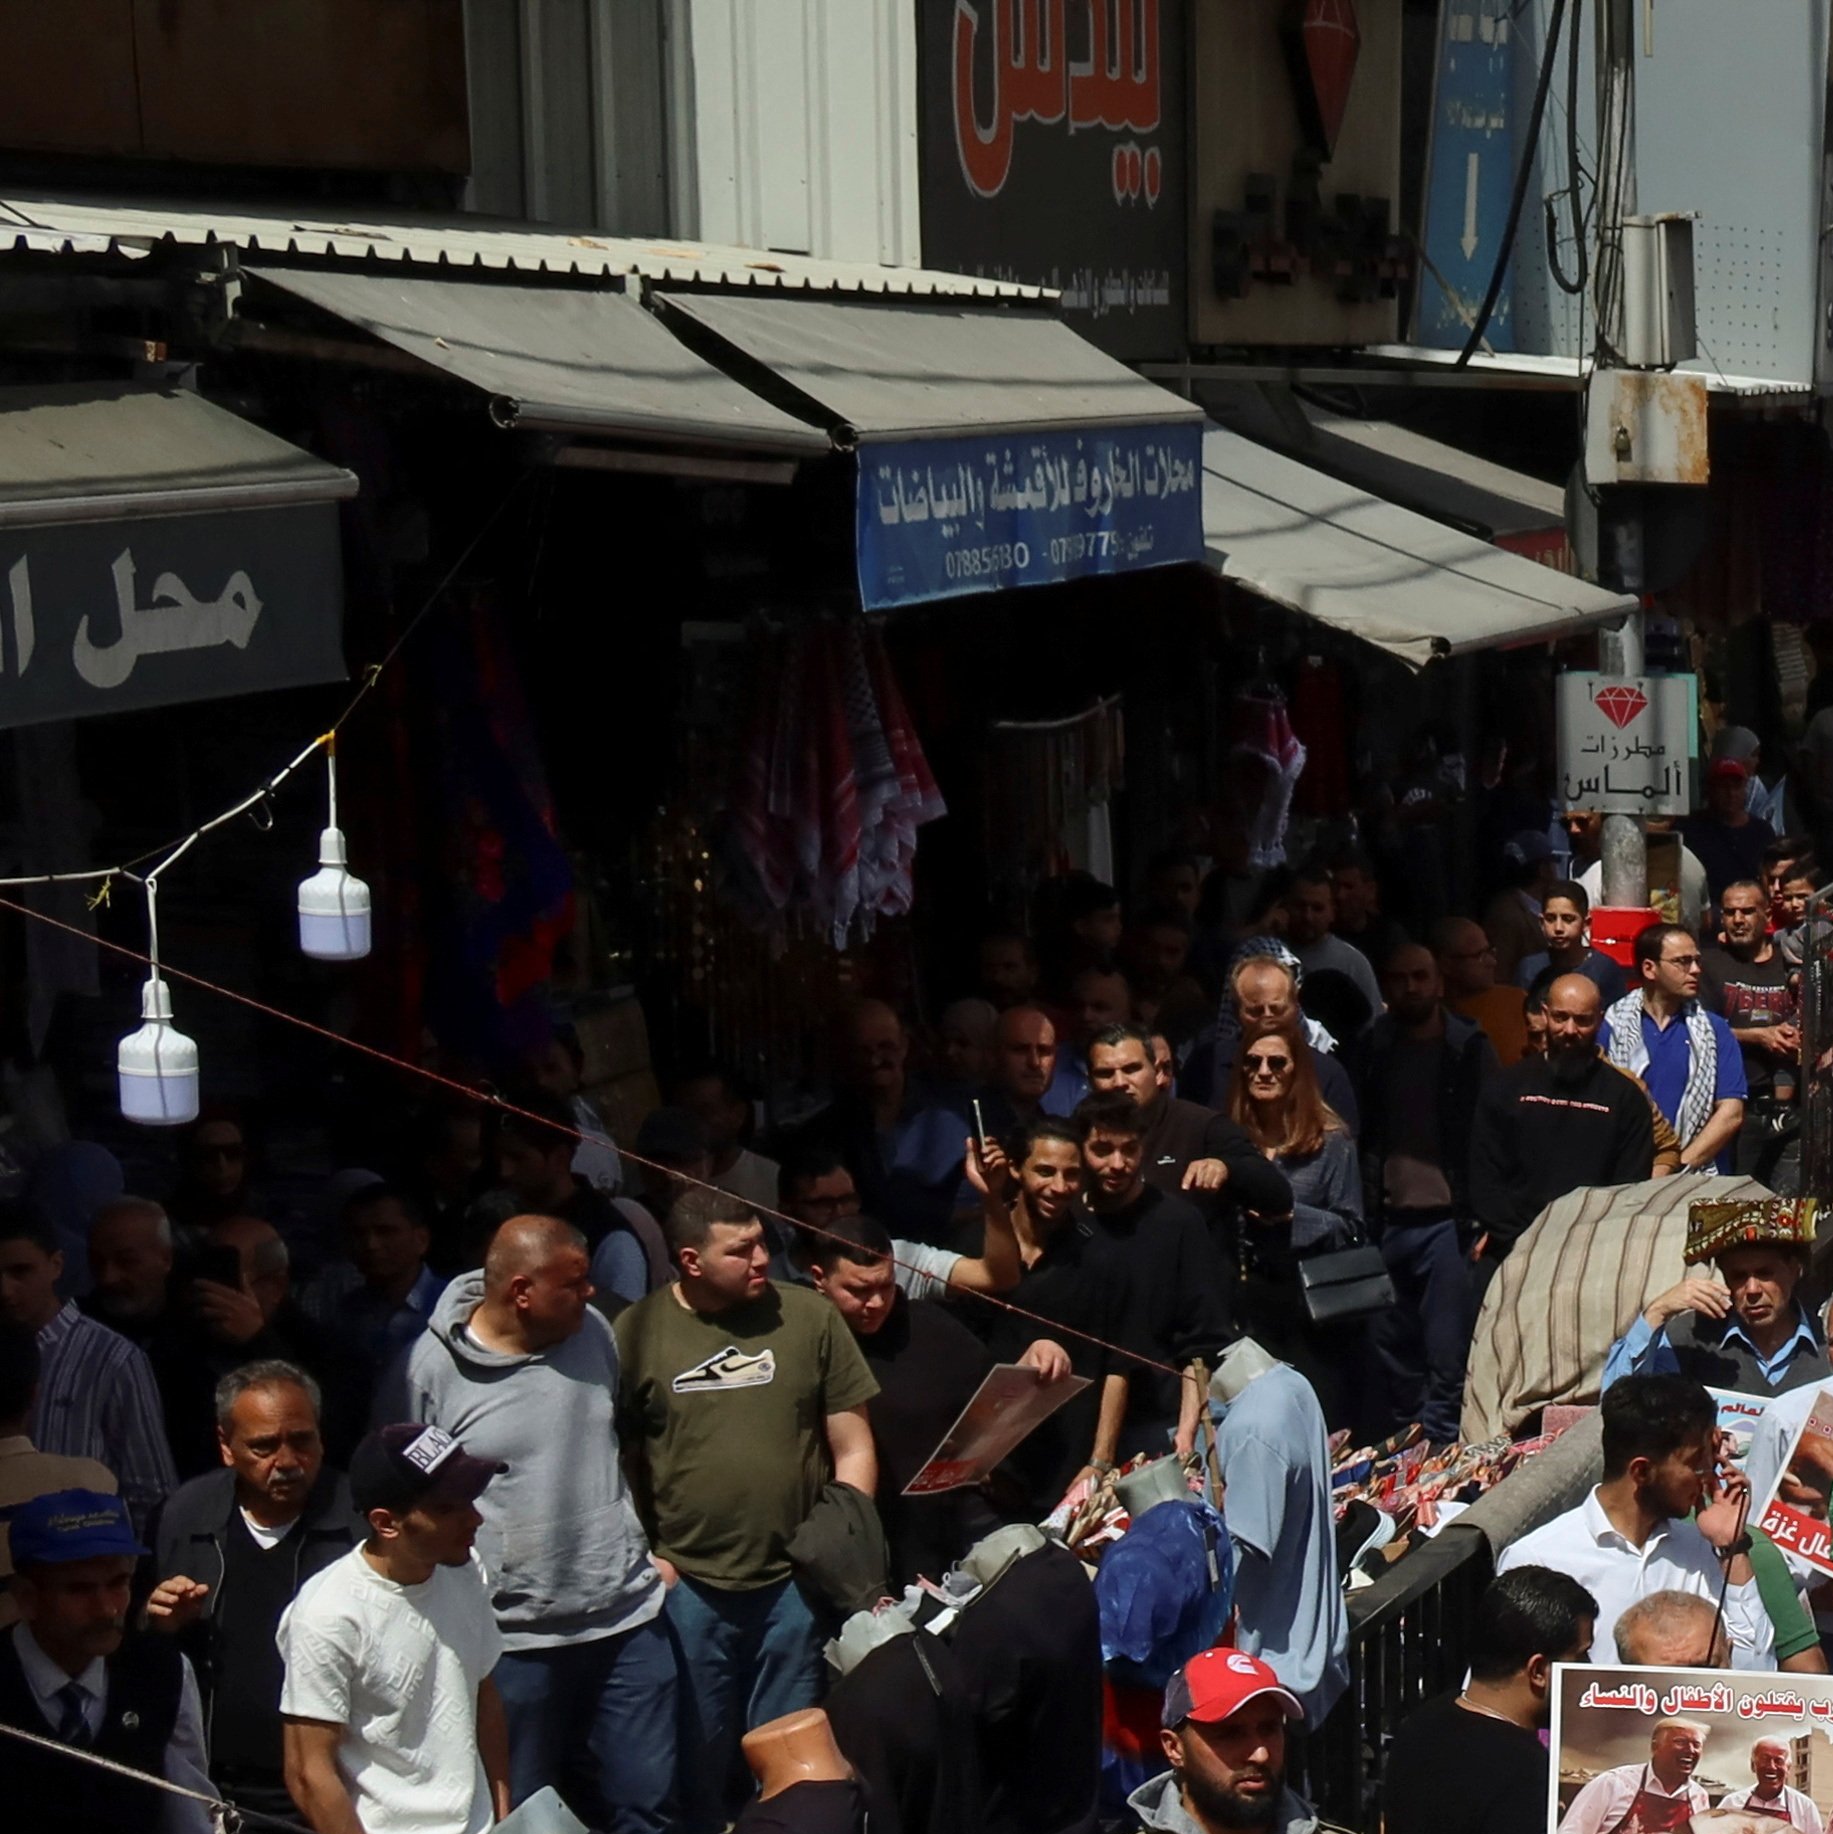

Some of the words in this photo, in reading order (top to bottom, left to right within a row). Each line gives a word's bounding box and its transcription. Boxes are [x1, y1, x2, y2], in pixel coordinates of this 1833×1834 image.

[986, 445, 1071, 511] للأقمشة
[1144, 445, 1194, 499] محلات
[878, 462, 986, 538] والبياضات
[73, 549, 263, 688] محل
[1581, 736, 1665, 760] مطرزات
[1565, 761, 1681, 800] ألماس
[1761, 1509, 1799, 1542] غزة
